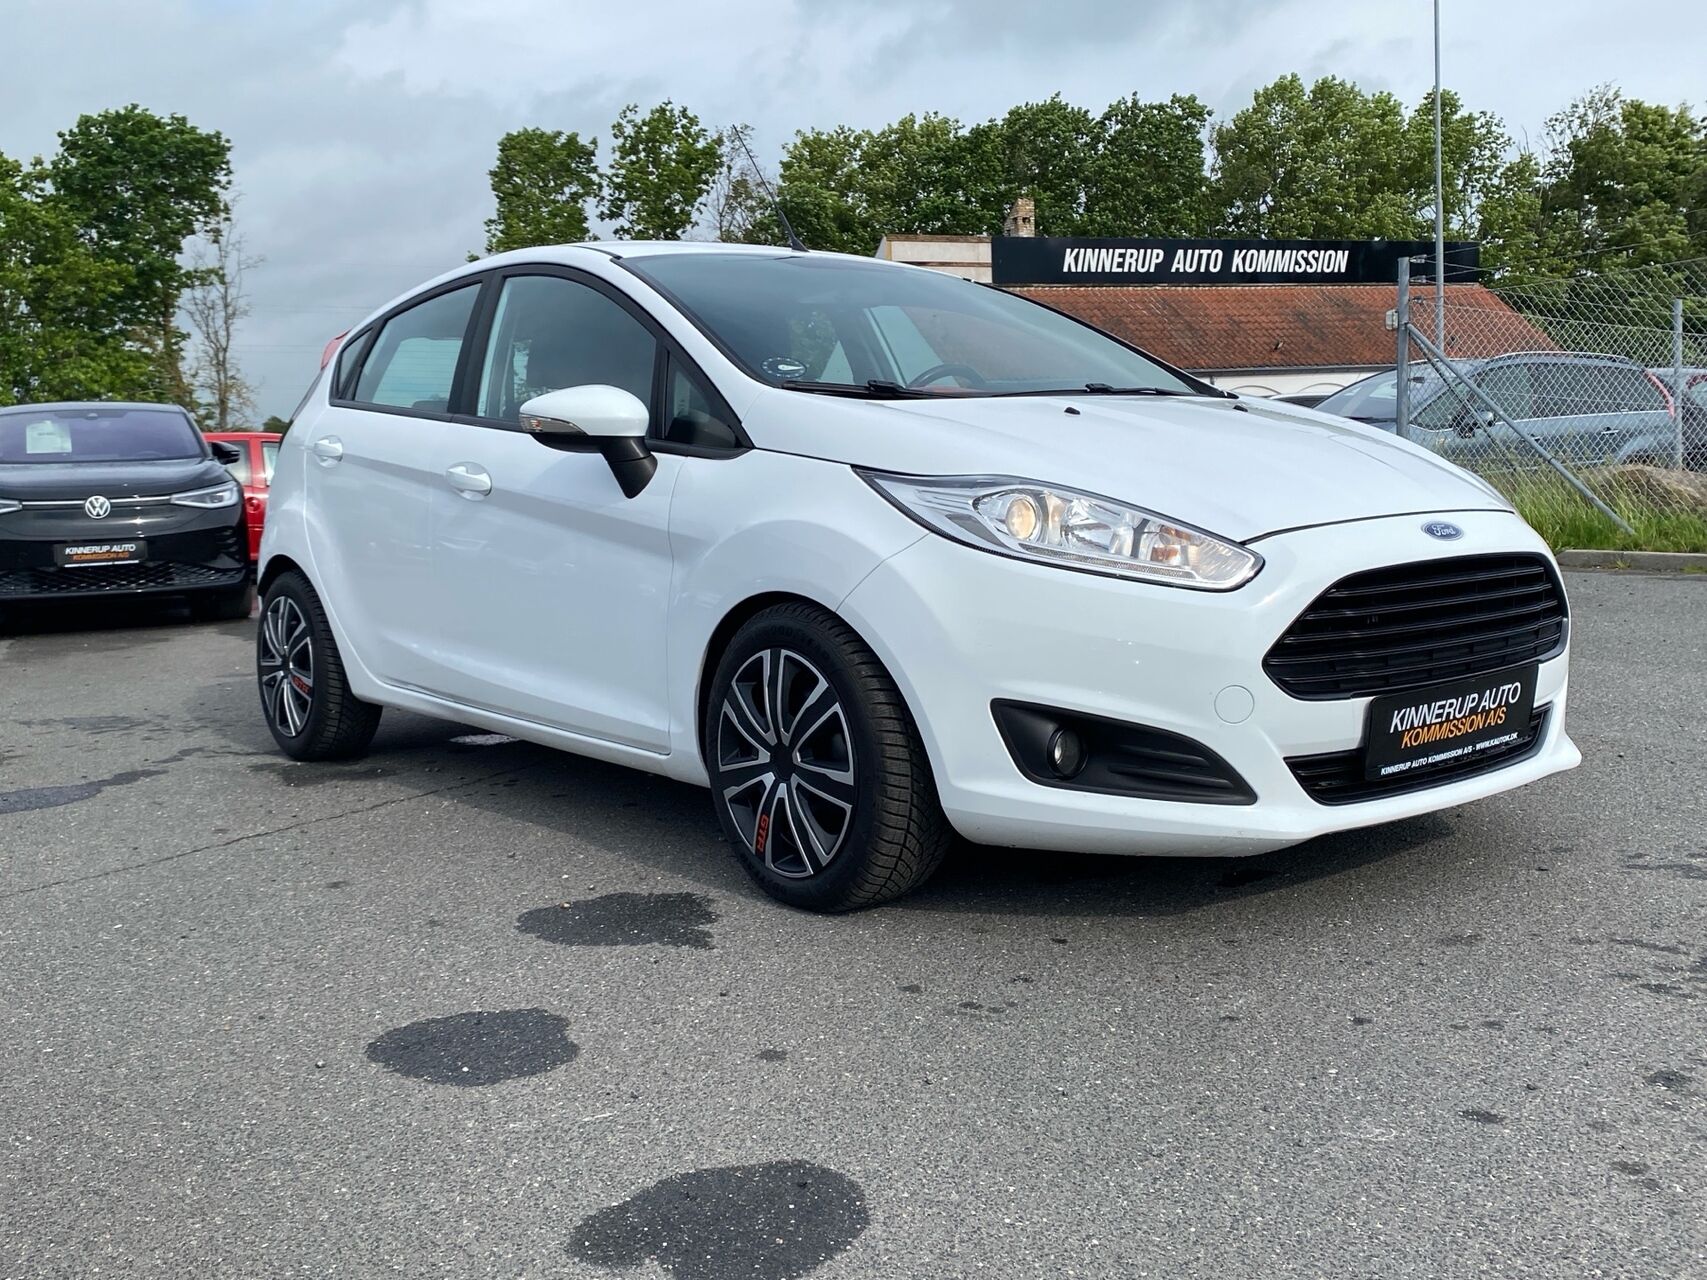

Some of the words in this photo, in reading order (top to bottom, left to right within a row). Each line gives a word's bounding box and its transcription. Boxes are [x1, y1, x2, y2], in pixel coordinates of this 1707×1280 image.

[1062, 247, 1164, 274] KINNERUP
[1171, 248, 1223, 274] AUTO
[1231, 249, 1349, 274] KOMMISSION
[1431, 524, 1456, 536] Ford
[65, 545, 110, 555] KINNERUP
[111, 543, 136, 553] AUTO
[1390, 693, 1479, 733] KINNERUP
[1479, 682, 1522, 712] AUTO
[1401, 713, 1487, 749] KOMMISSION
[1485, 707, 1507, 726] A/S
[1380, 763, 1411, 776] KINNERUP
[1411, 757, 1428, 768] AUTO
[1427, 747, 1463, 764] KOMMISSION
[1462, 745, 1473, 754] A/S
